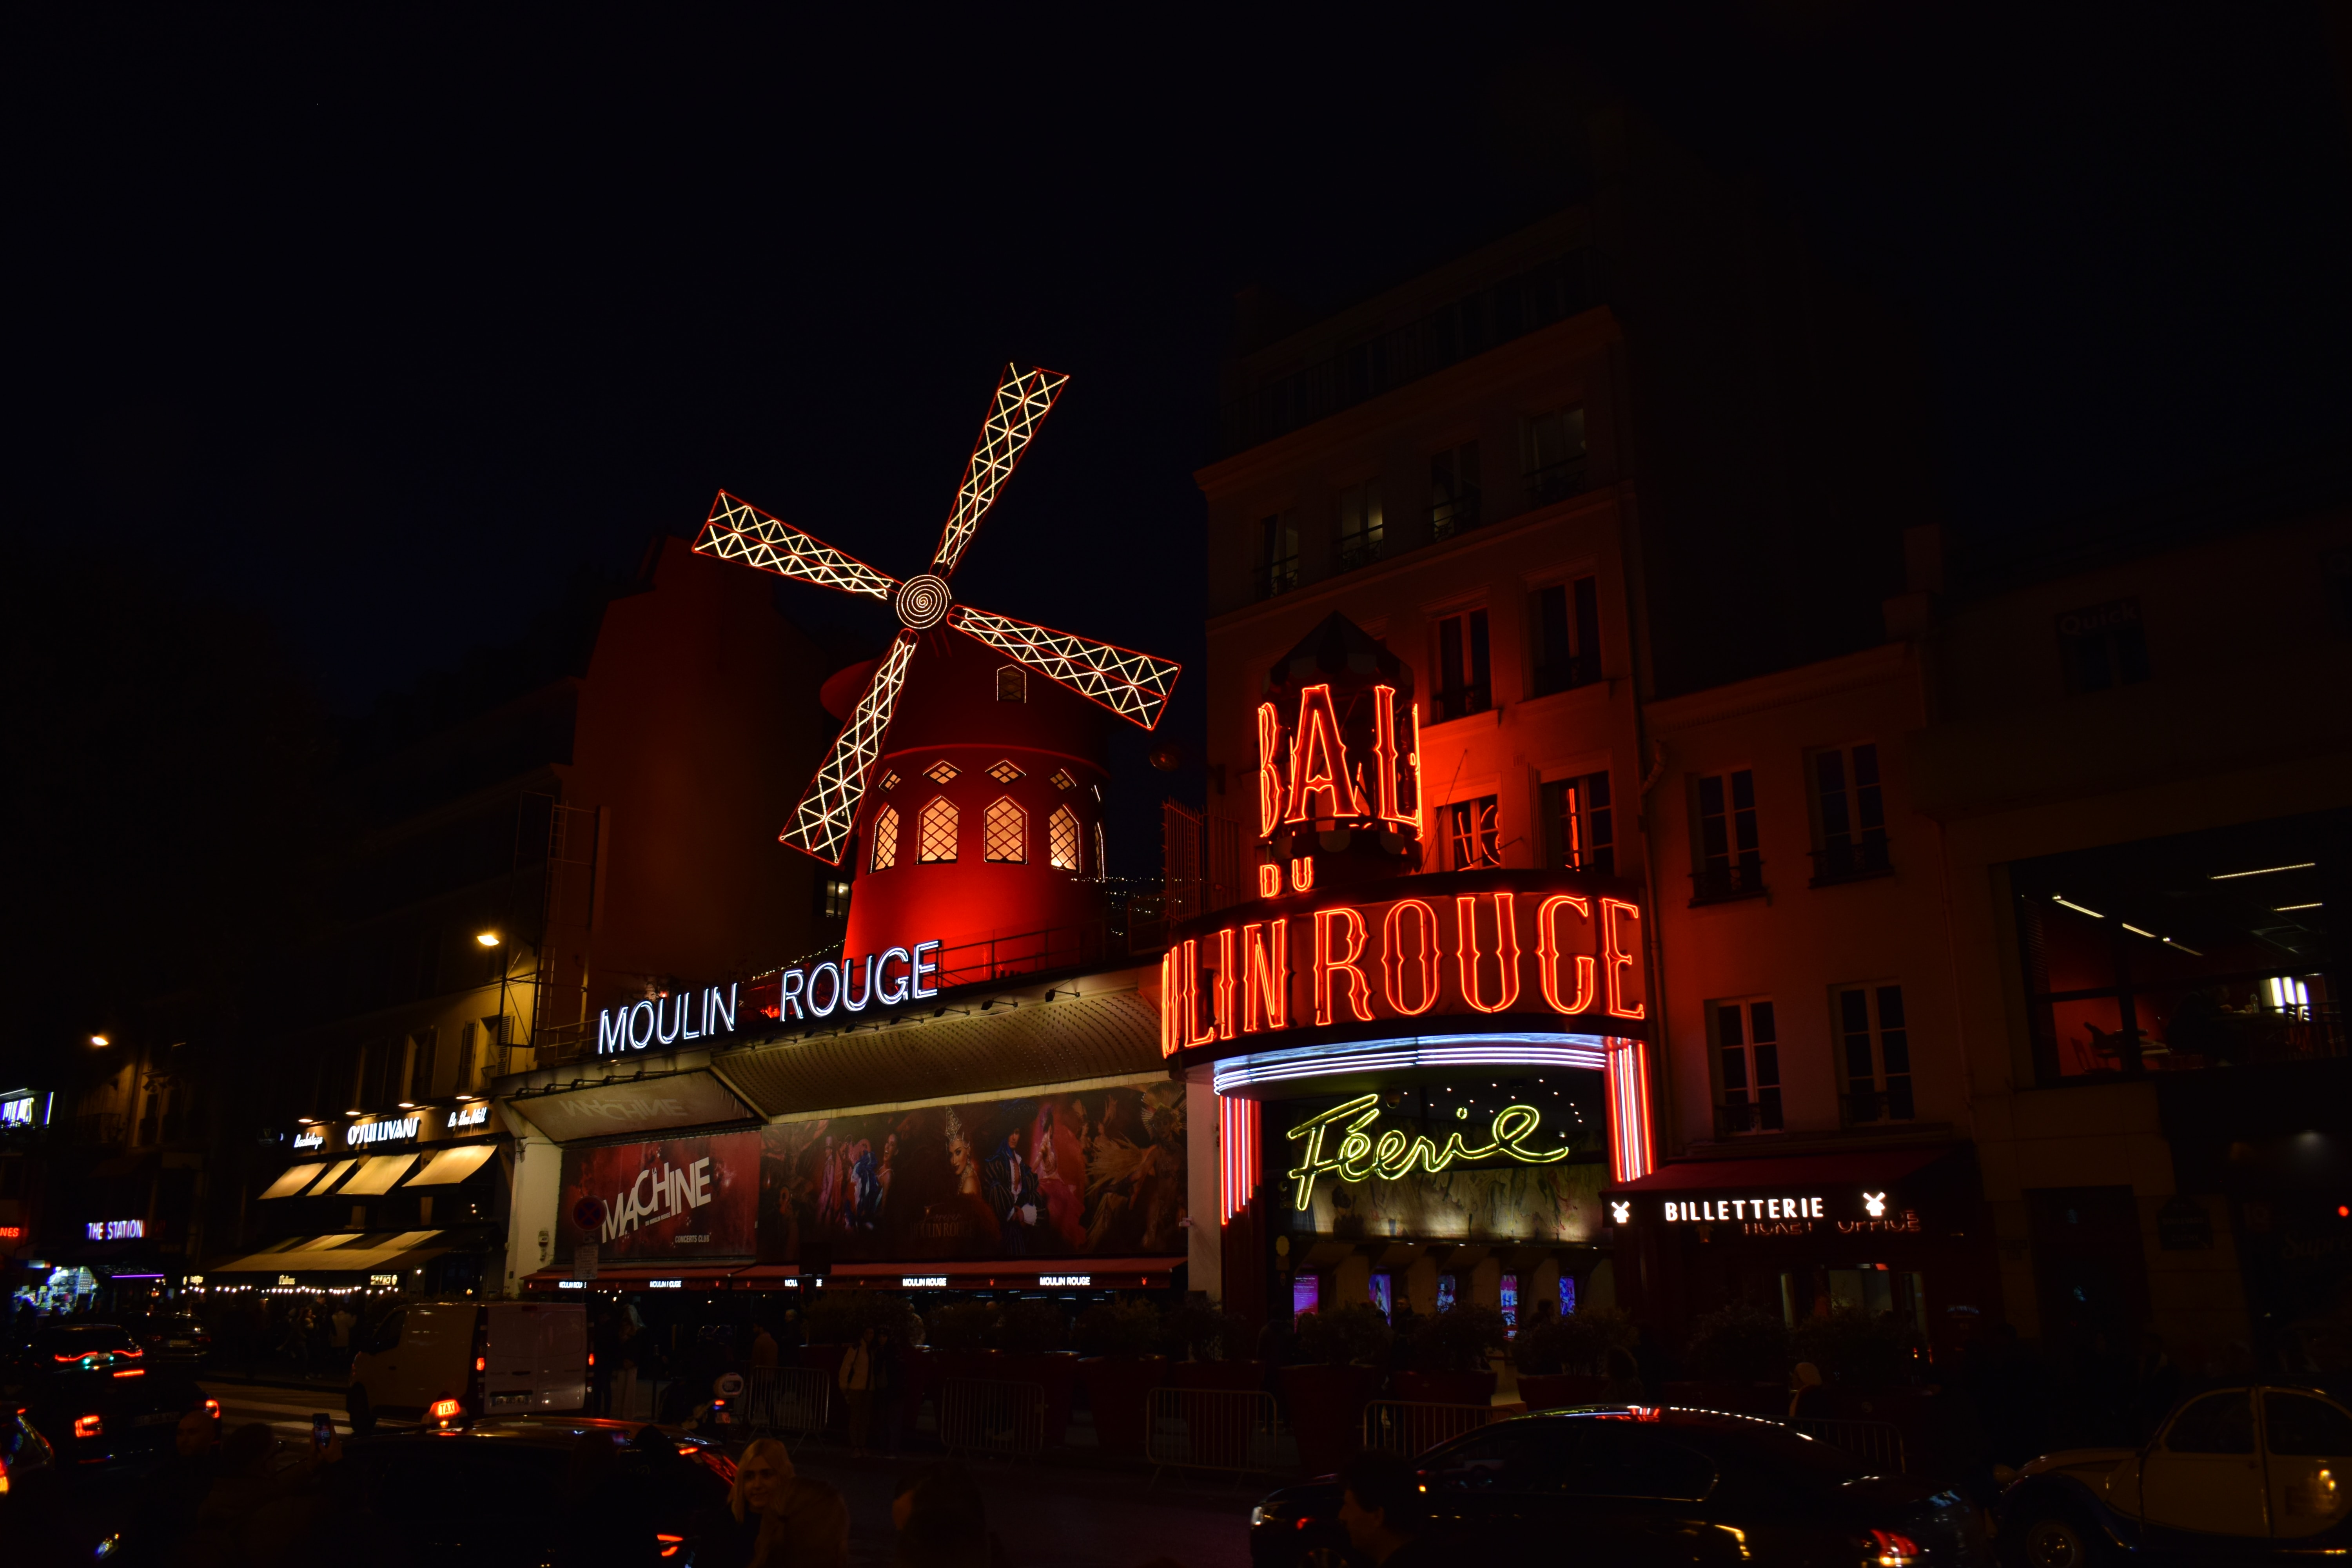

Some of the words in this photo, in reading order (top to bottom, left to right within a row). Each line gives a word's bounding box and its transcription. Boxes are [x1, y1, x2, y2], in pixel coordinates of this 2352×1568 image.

[2060, 603, 2137, 635] Quick
[1258, 684, 1419, 838] BAL
[1259, 857, 1314, 898] DU
[1313, 892, 1646, 1026] ROUGE
[597, 982, 738, 1055] MOULIN
[779, 939, 942, 1022] ROUGE
[458, 1110, 470, 1126] the
[469, 1107, 487, 1124] Mill
[1286, 1093, 1570, 1211] Féerie
[602, 1157, 711, 1244] MACHINE
[1664, 1197, 1824, 1221] BILLETTERIE
[650, 1216, 661, 1225] MOULIN
[920, 1202, 962, 1224] Forever
[2162, 1217, 2204, 1226] BOULEVARD
[87, 1222, 103, 1240] THE
[107, 1219, 144, 1240] STATION
[909, 1222, 942, 1239] MOULIN
[943, 1221, 974, 1238] ROUGE
[160, 1244, 181, 1252] BAR
[926, 1278, 947, 1286] ROUGE
[1040, 1277, 1065, 1285] MOULIN
[1067, 1277, 1091, 1285] ROUGE
[440, 1402, 455, 1414] TAXI
